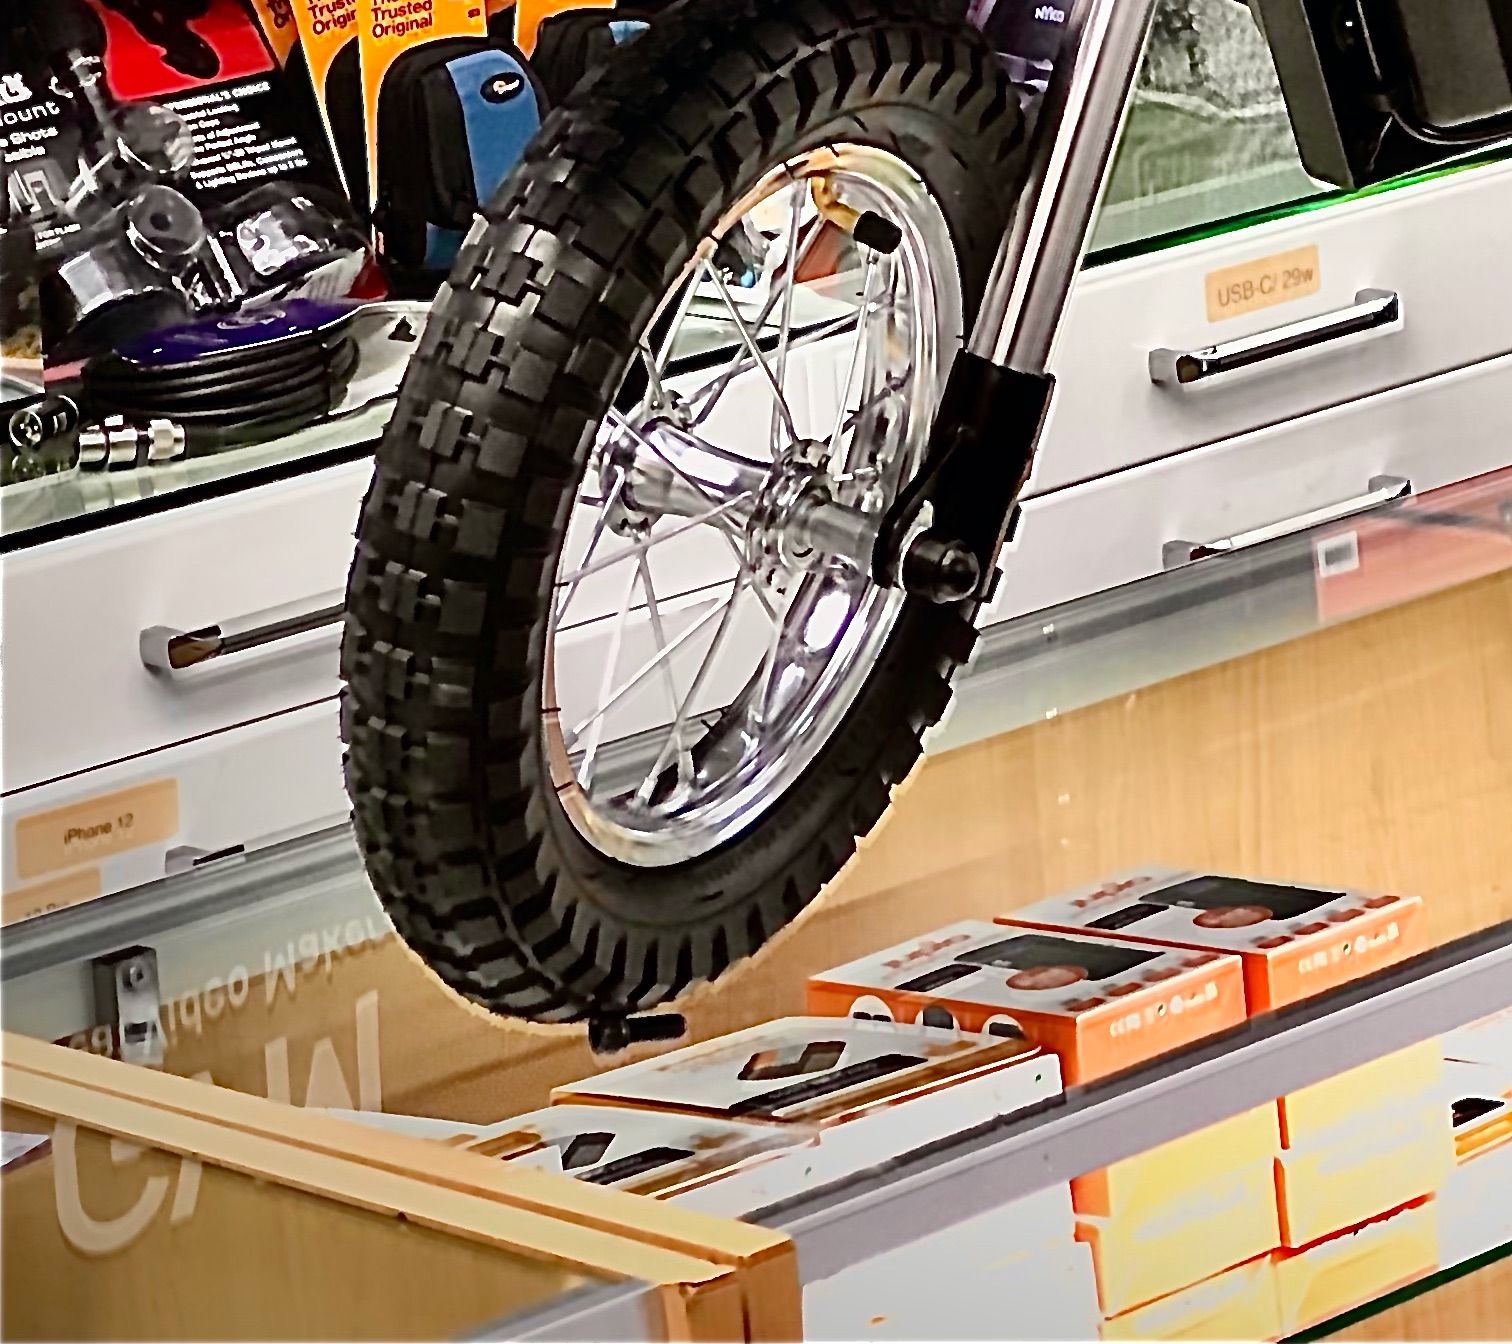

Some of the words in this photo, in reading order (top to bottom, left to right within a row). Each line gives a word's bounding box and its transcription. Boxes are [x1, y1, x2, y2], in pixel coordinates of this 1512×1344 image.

[372, 13, 433, 40] Original
[1282, 267, 1314, 291] 29w
[63, 821, 113, 846] iPhone
[117, 812, 134, 829] 12
